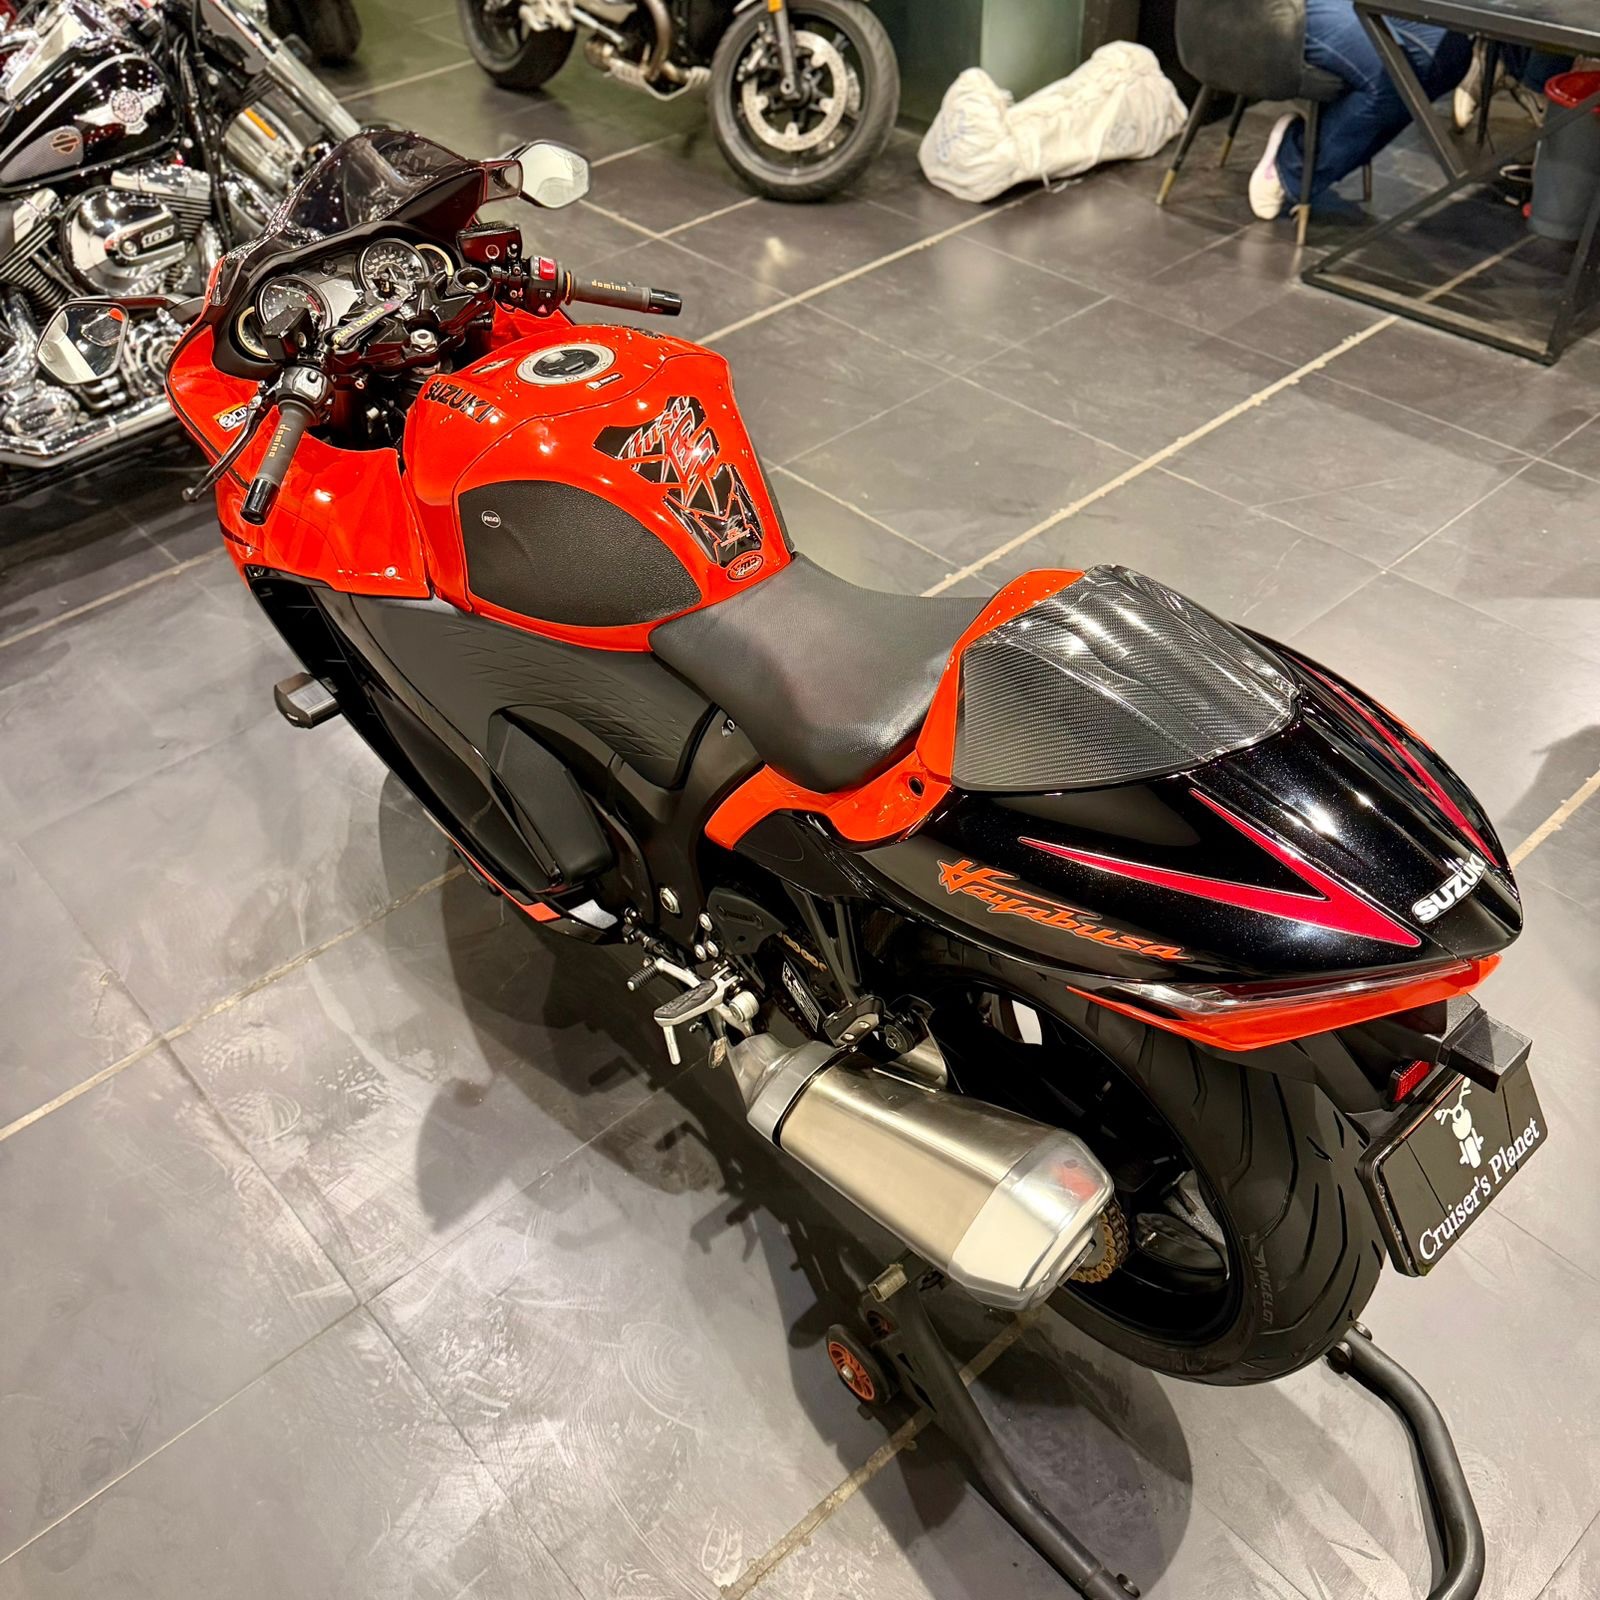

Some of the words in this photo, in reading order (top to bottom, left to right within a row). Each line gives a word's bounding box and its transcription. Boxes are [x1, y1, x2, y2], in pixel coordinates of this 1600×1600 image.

[591, 279, 627, 292] domino
[424, 381, 496, 423] SUZUKI
[268, 423, 292, 458] domino
[938, 858, 1193, 962] Hayabusa
[1414, 853, 1486, 921] SUZUKI
[1419, 1176, 1492, 1260] Cruiser's
[1488, 1117, 1540, 1184] Planet
